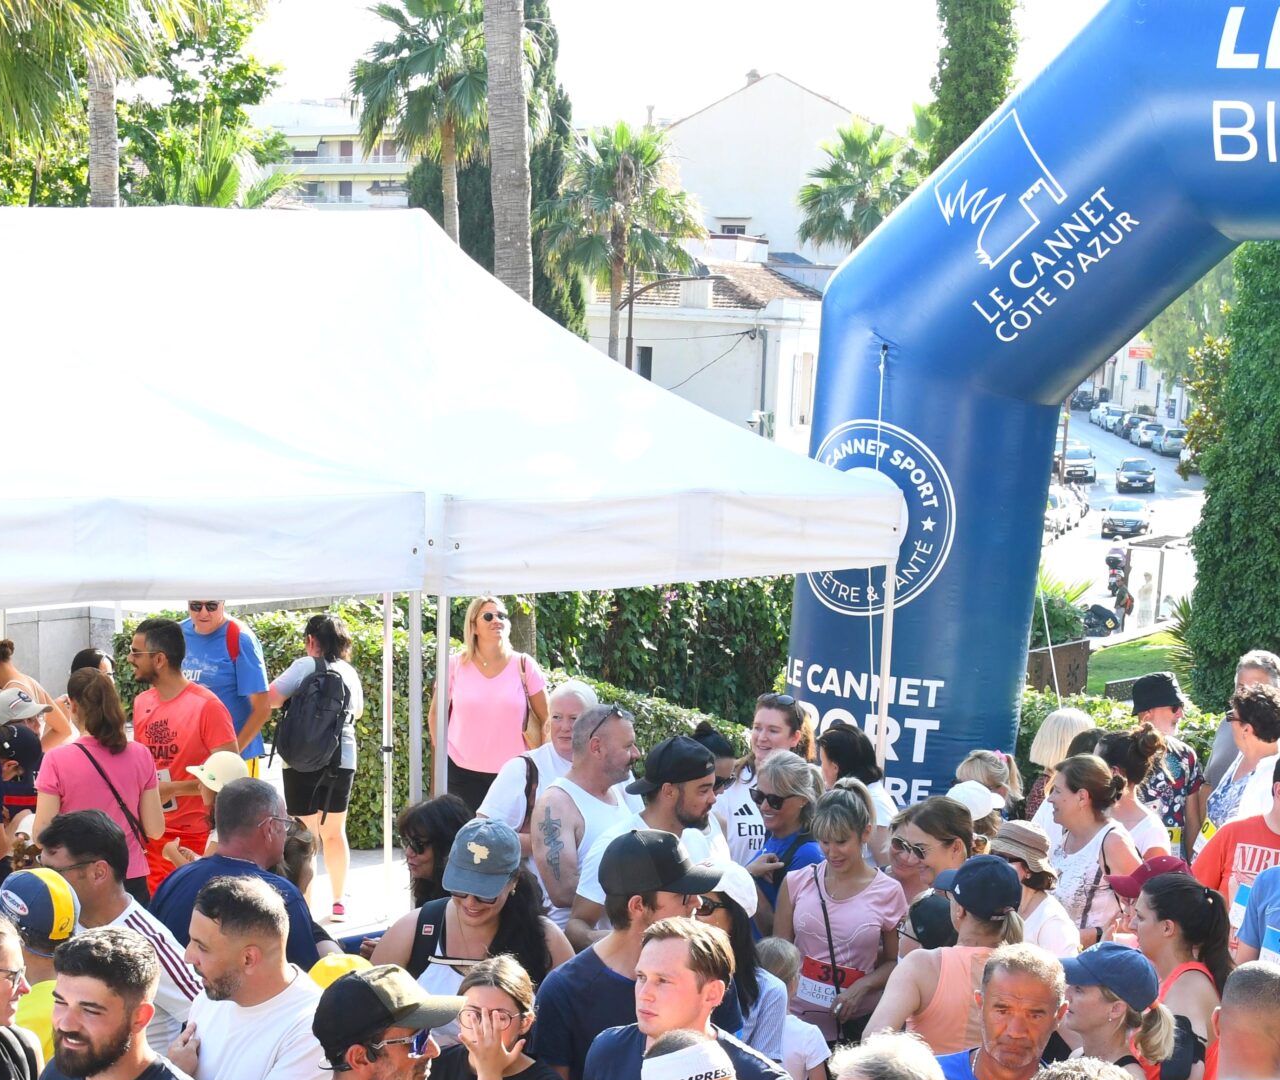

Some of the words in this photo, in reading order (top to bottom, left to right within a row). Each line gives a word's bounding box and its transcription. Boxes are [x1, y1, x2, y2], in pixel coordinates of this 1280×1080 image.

[972, 287, 1013, 324] LE
[1009, 186, 1115, 288] CANNET
[1053, 211, 1140, 290] D'AZUR
[889, 449, 938, 508] SPORT
[881, 540, 933, 591] ANTÉ
[787, 656, 803, 688] LE
[806, 664, 945, 708] CANNET
